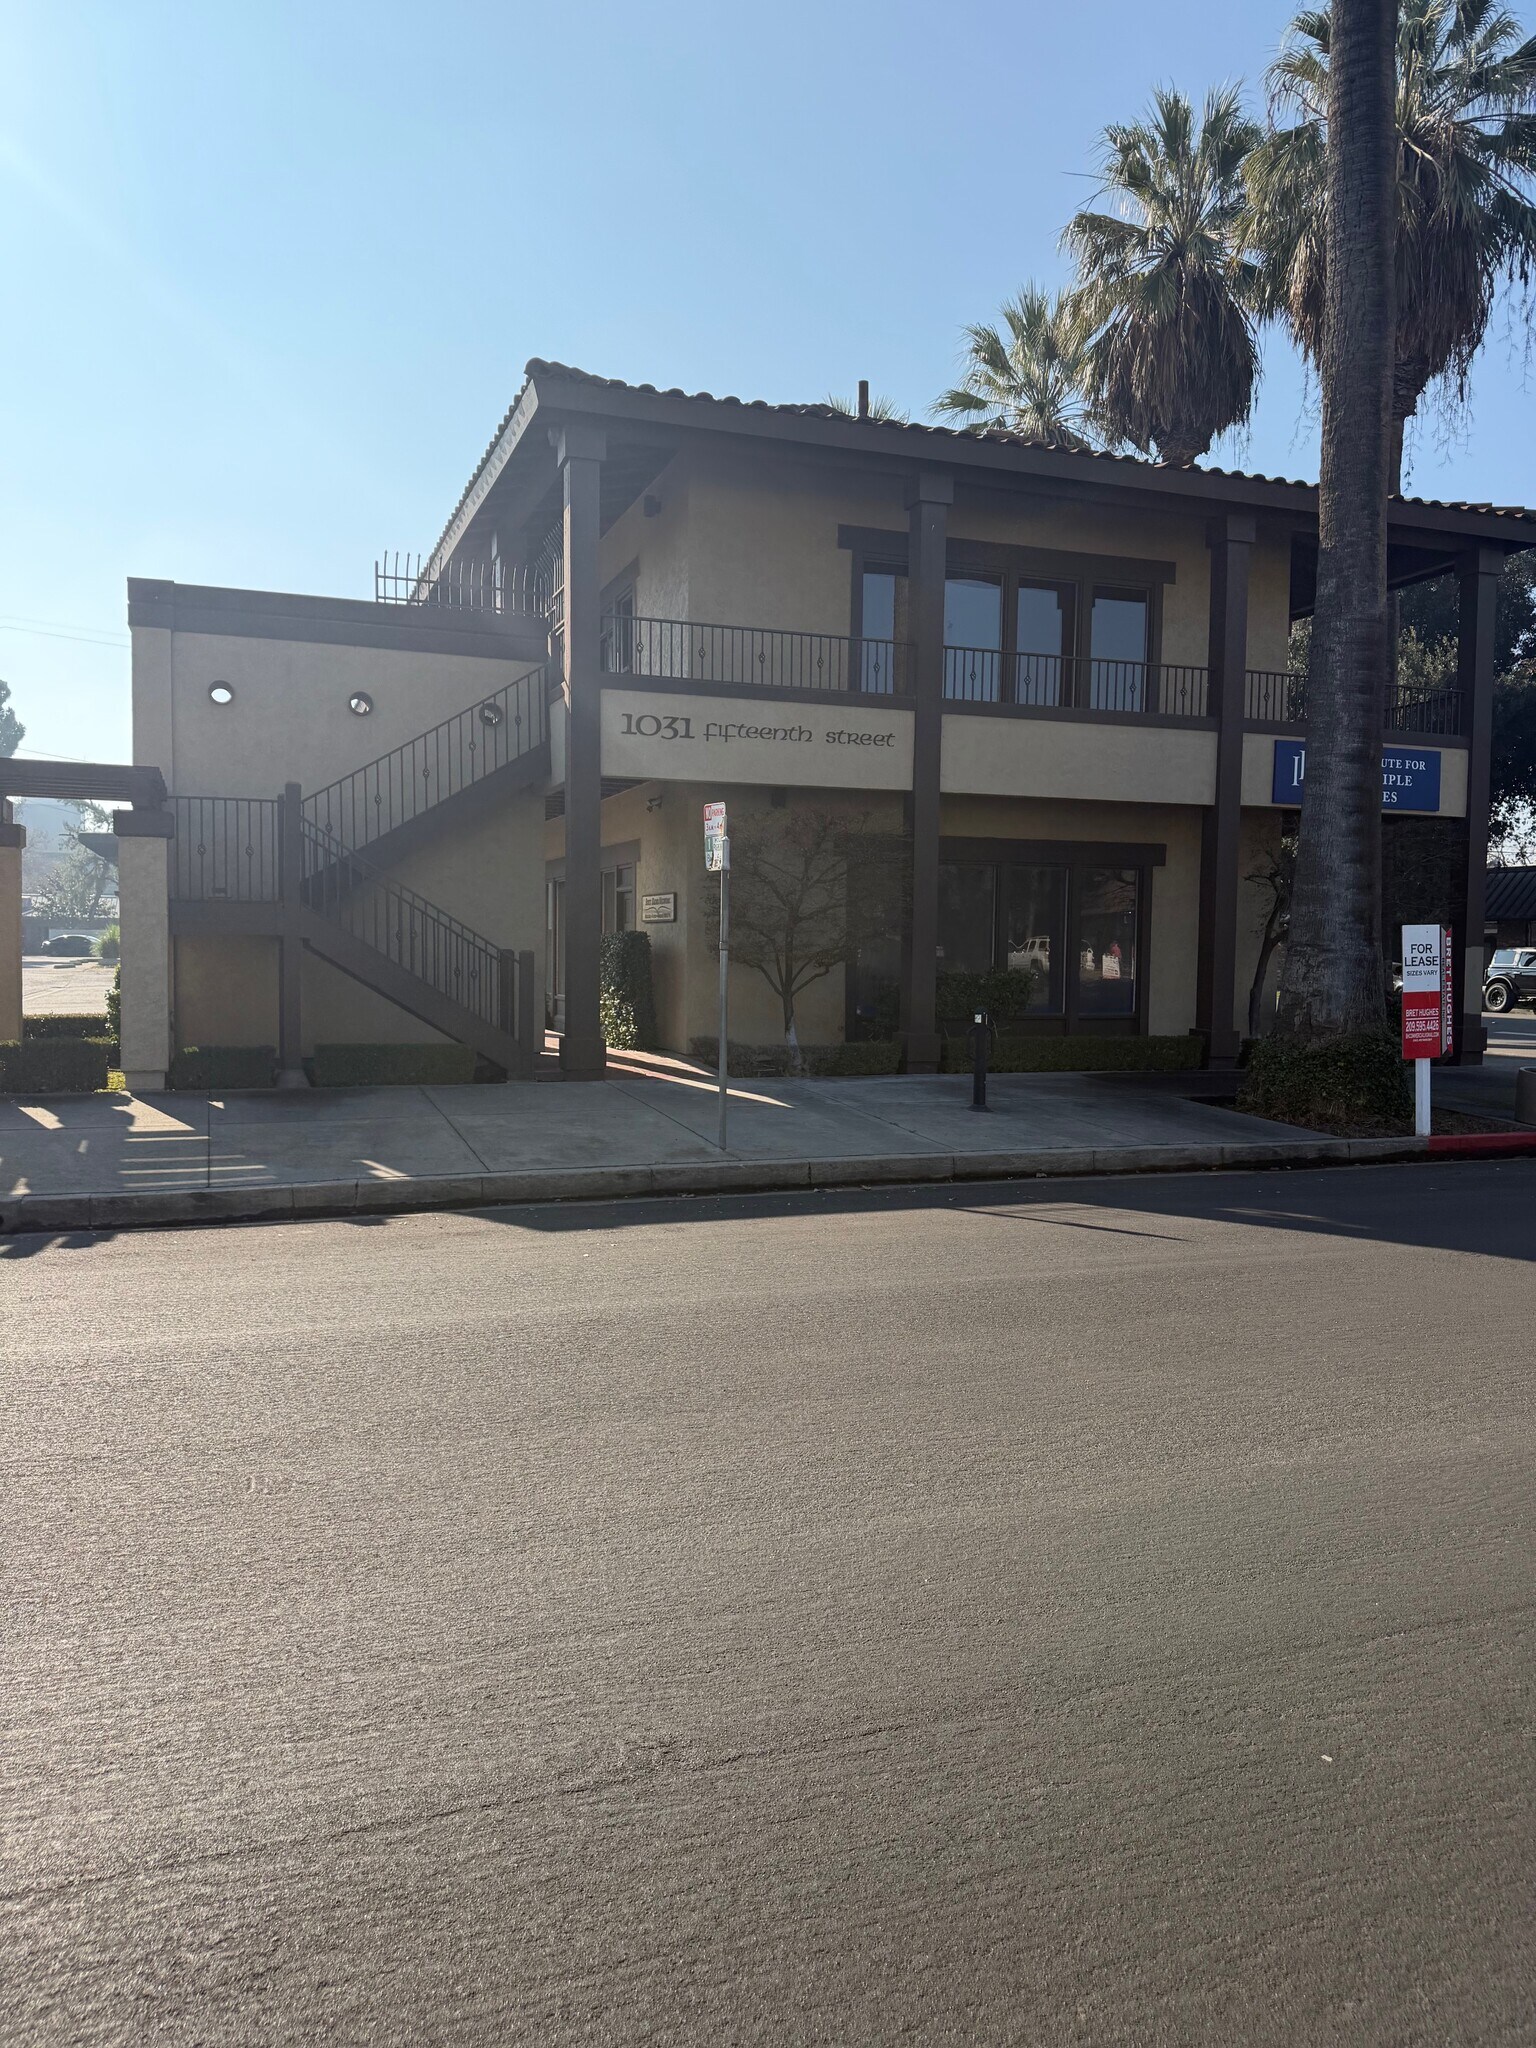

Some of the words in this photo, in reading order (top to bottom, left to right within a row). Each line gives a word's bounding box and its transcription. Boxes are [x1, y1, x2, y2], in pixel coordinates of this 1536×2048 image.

[621, 713, 695, 740] 1031
[703, 723, 813, 743] fifteenth
[1404, 760, 1426, 770] FOR
[1410, 943, 1433, 954] FOR
[1404, 956, 1439, 967] LEASE
[1405, 1008, 1418, 1017] BRET
[1418, 1007, 1439, 1017] HUGHES
